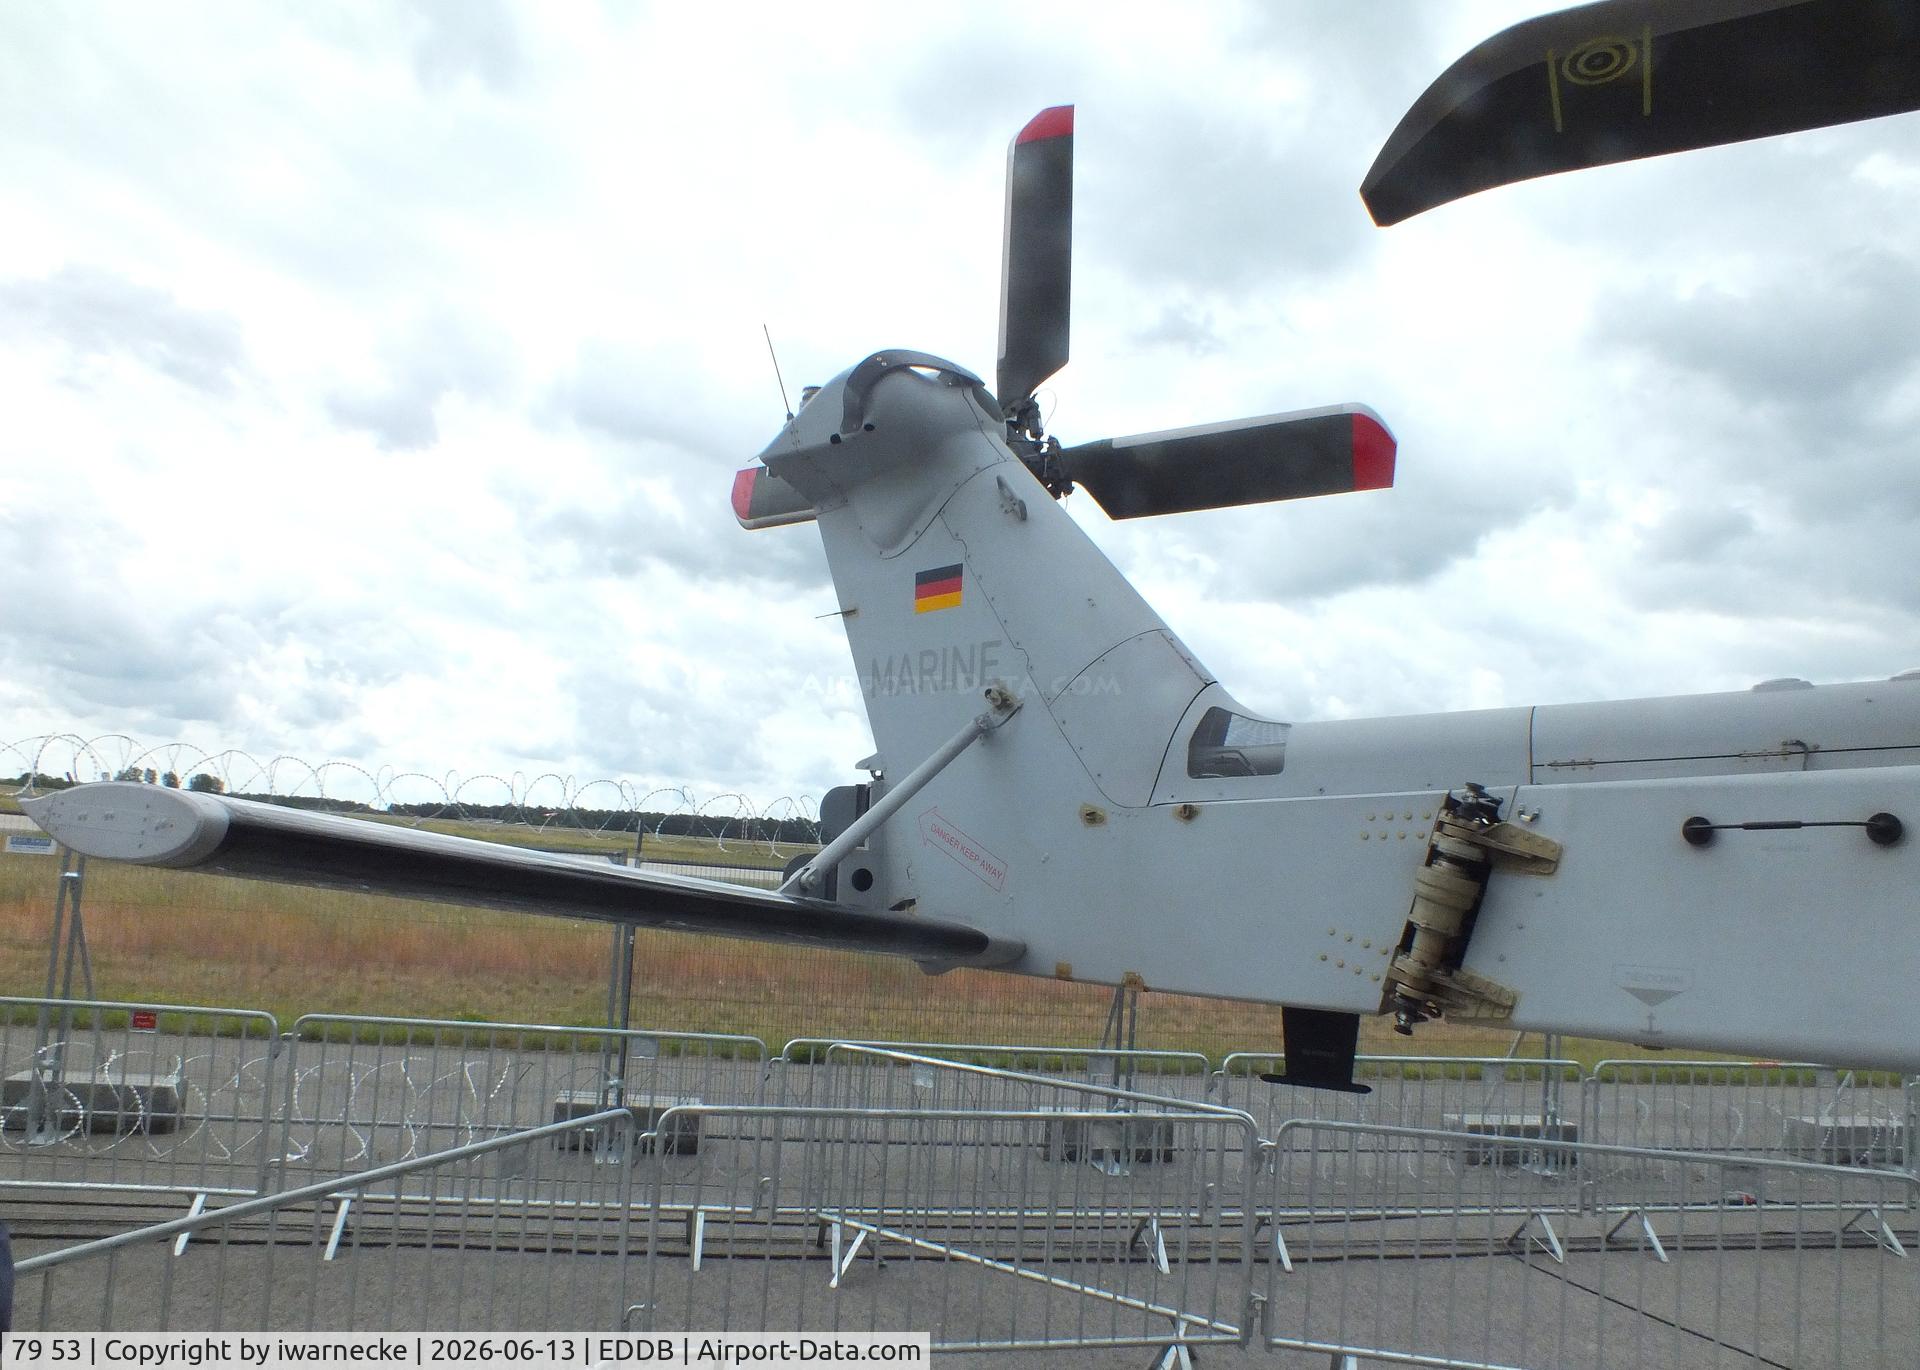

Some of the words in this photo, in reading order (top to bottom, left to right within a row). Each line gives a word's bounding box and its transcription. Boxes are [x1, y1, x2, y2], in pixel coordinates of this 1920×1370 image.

[870, 639, 1003, 697] MARINE
[930, 823, 961, 849] DANGER
[960, 845, 980, 862] KEEP
[979, 859, 1003, 880] AWAY
